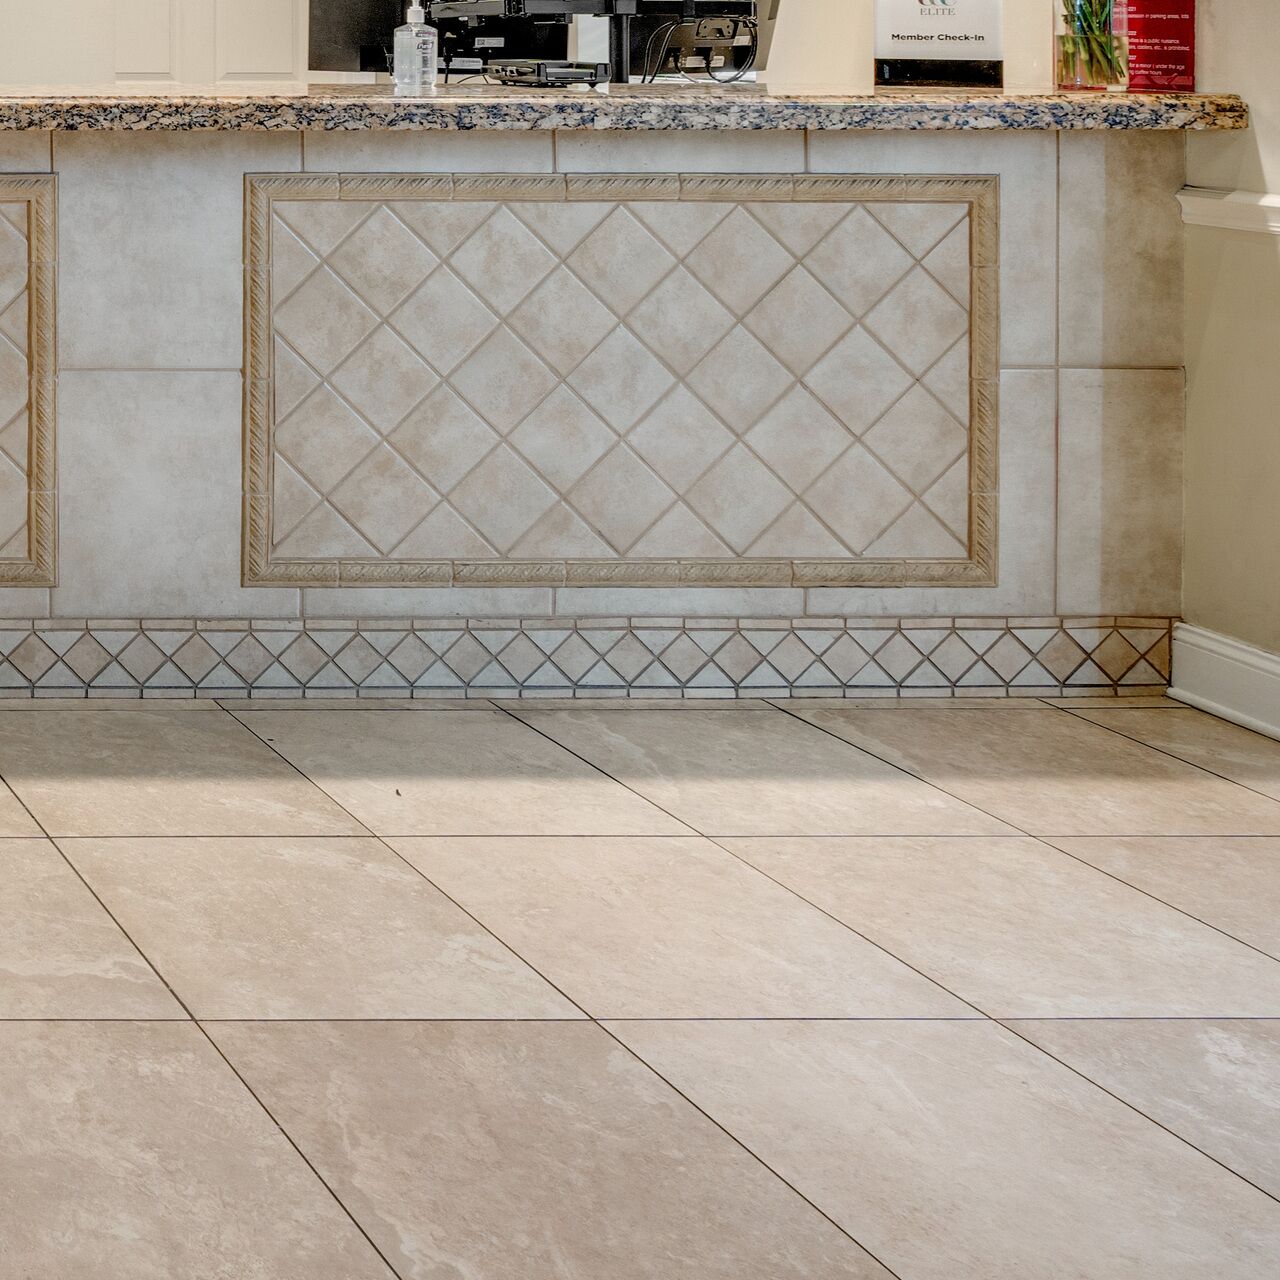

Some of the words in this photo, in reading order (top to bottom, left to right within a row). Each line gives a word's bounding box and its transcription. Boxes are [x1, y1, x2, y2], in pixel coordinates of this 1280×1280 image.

[920, 7, 956, 16] ELITE
[891, 33, 935, 41] Member
[936, 33, 985, 41] Check-In
